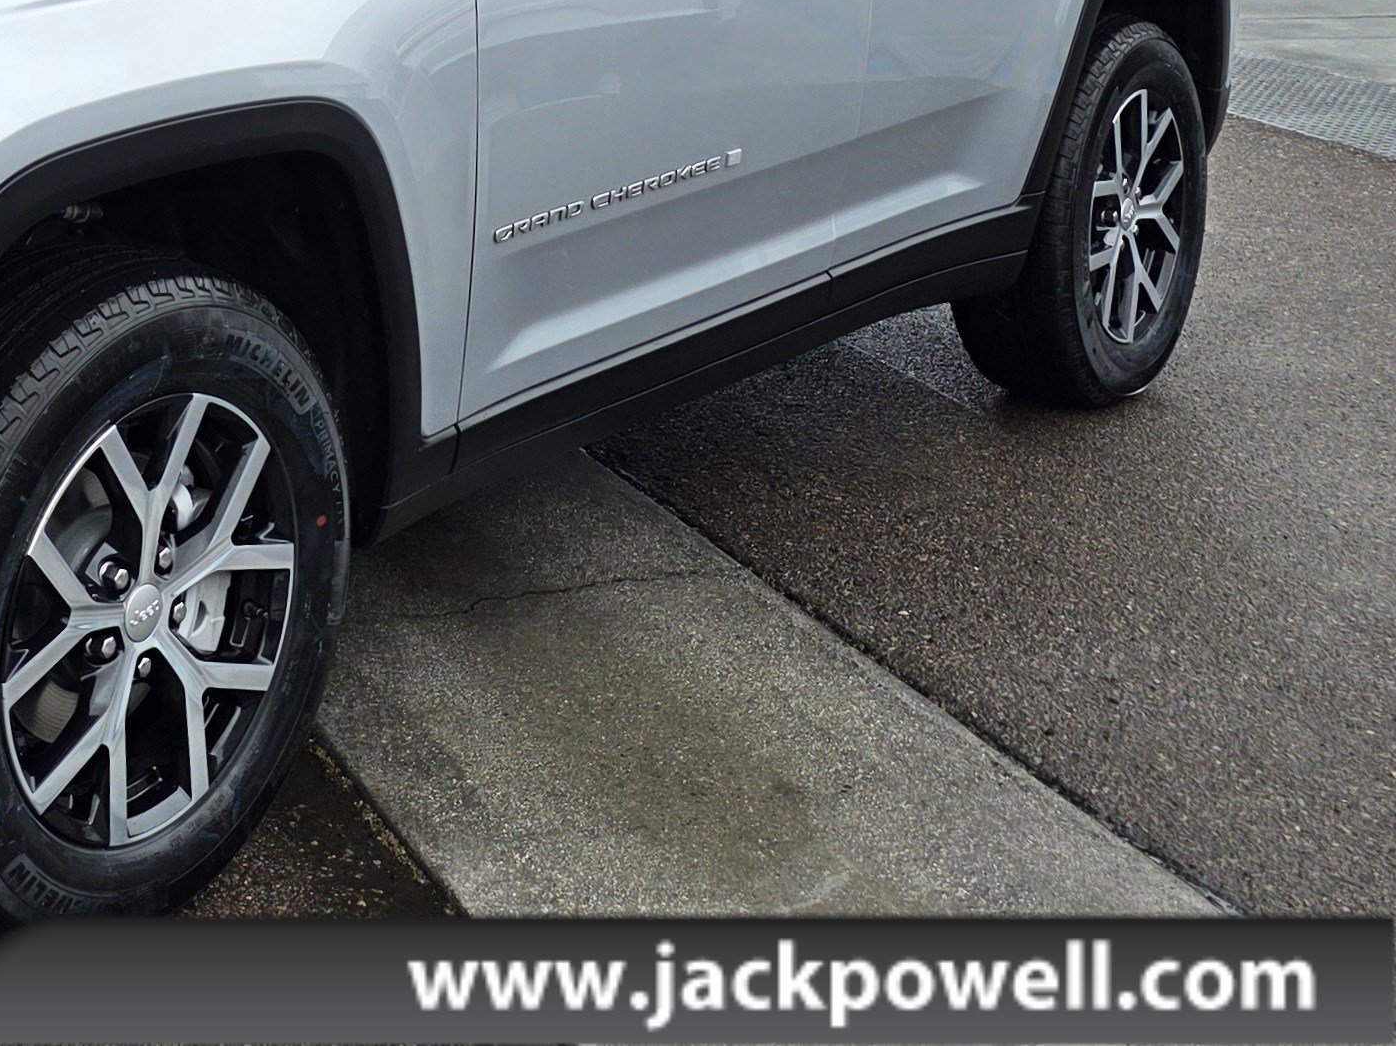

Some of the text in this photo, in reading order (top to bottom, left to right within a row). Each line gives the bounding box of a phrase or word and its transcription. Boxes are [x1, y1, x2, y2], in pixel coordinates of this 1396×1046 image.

[493, 156, 721, 244] GRAND CHEROKEE
[224, 333, 311, 408] MICHELIN
